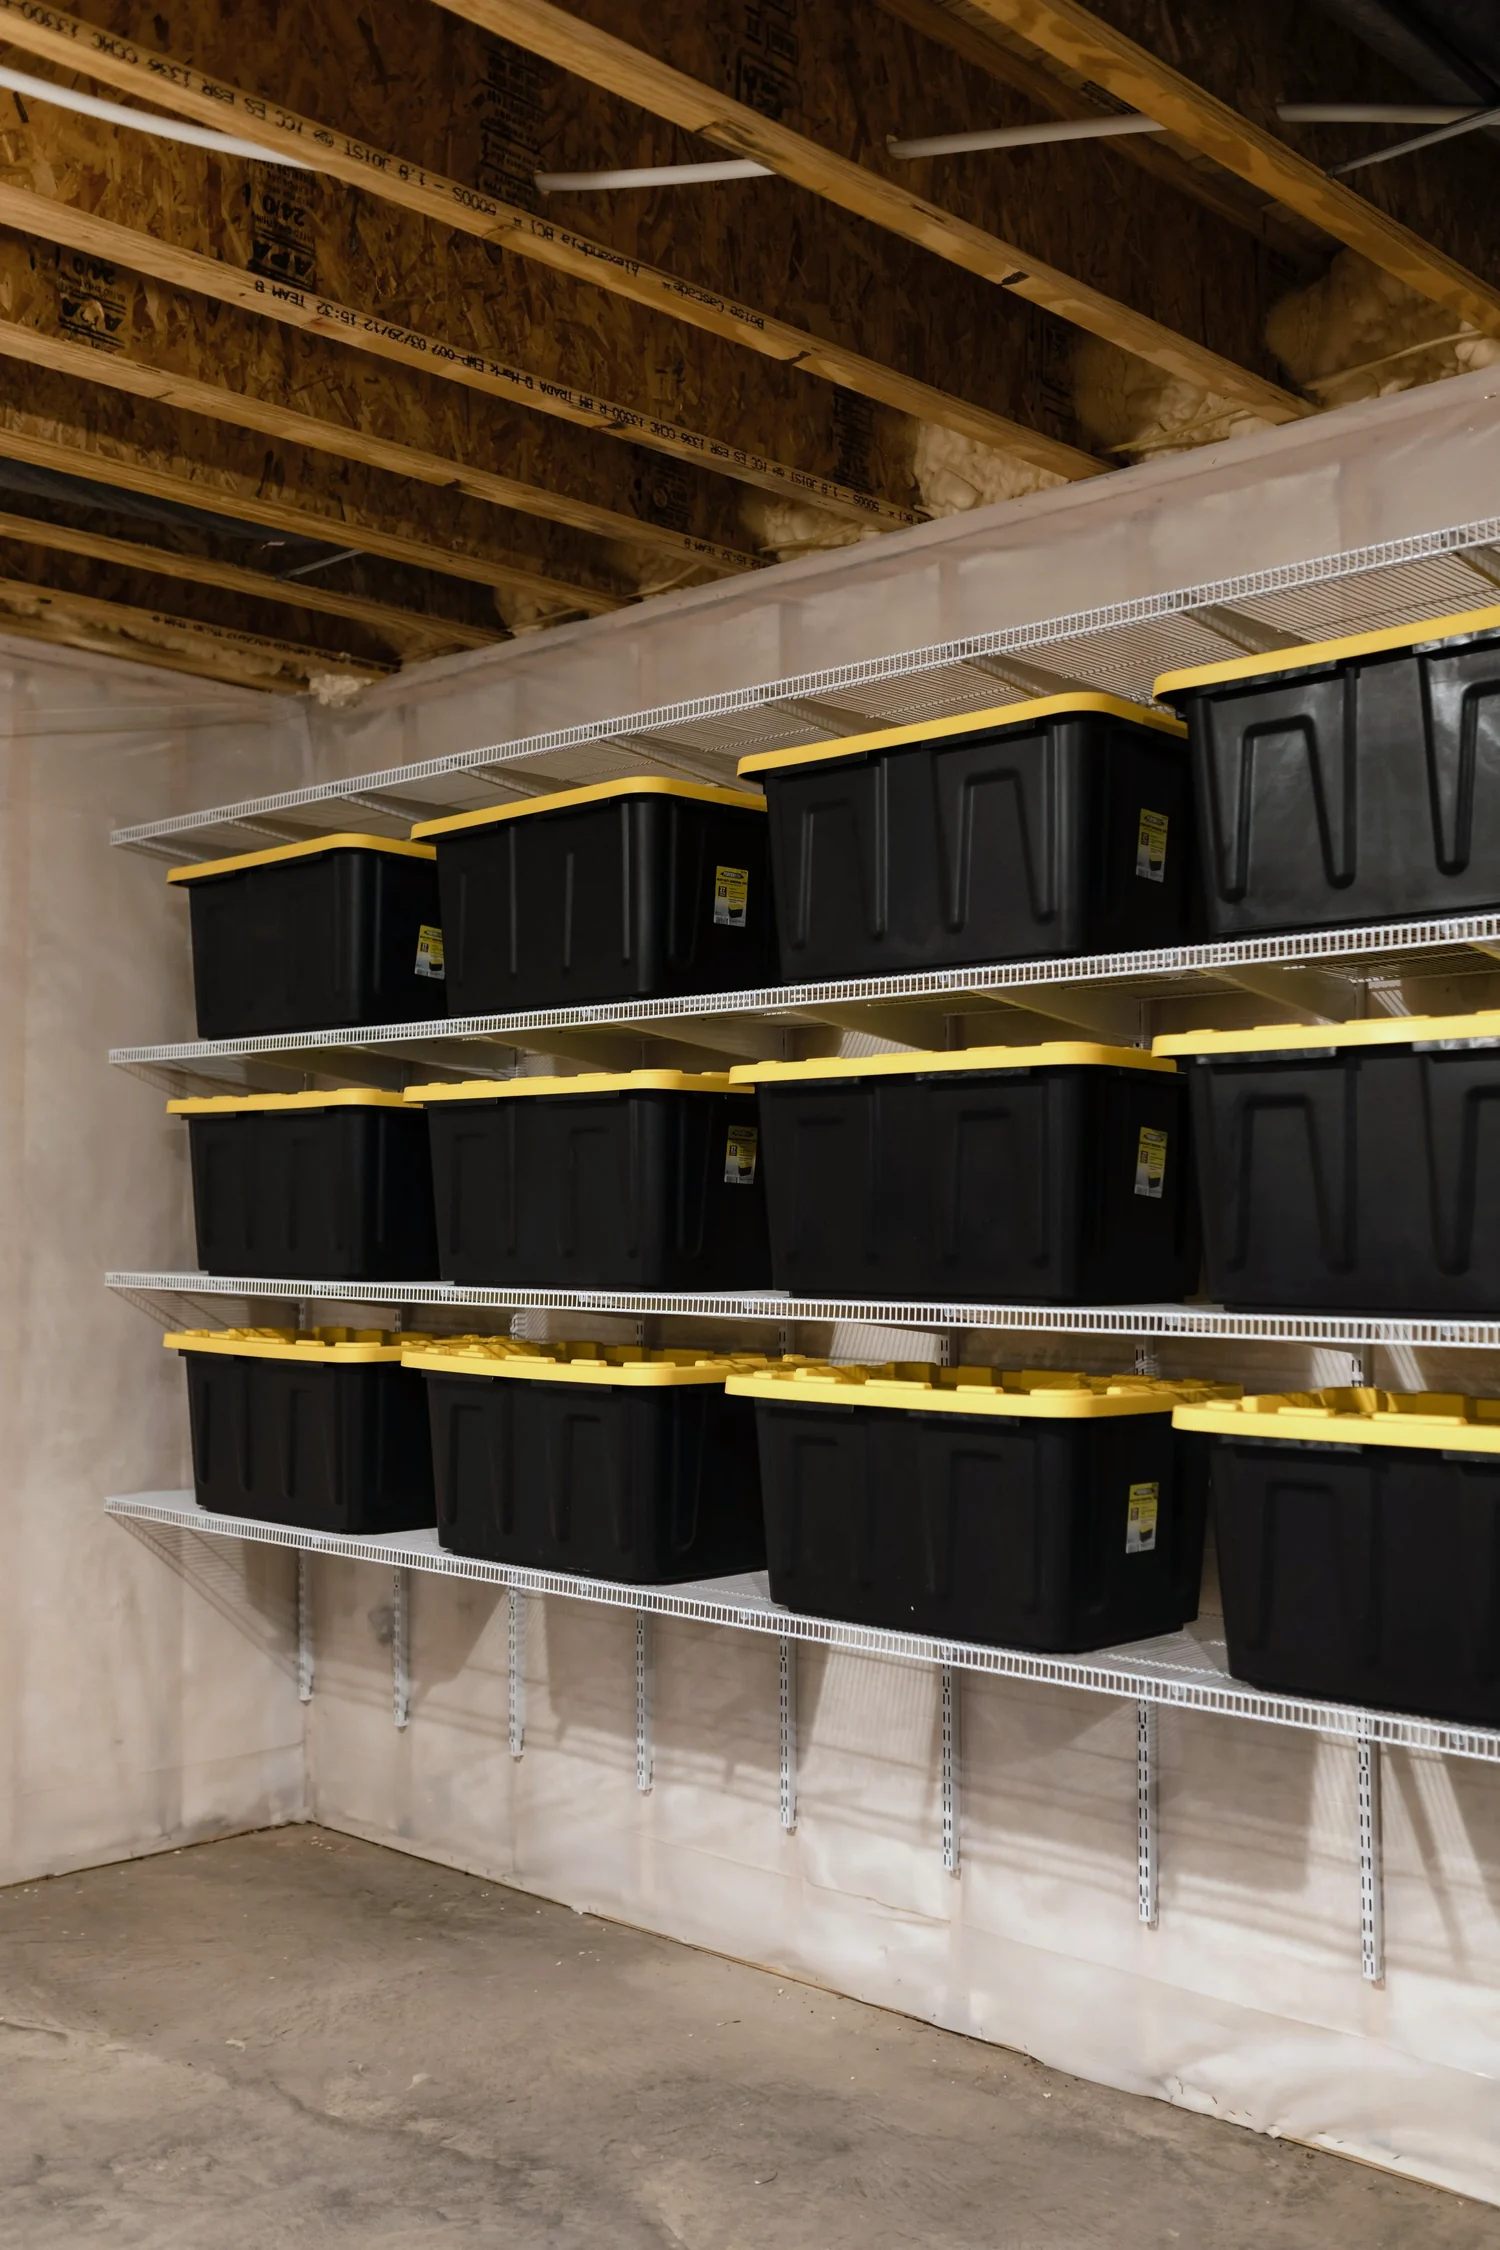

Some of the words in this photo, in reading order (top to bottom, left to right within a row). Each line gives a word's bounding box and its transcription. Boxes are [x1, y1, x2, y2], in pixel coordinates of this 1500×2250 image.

[91, 31, 139, 64] CCMC
[147, 57, 192, 88] 1336
[201, 77, 235, 105] ESR
[243, 97, 269, 121] ES
[275, 108, 304, 135] ICC
[343, 139, 392, 169] JOIST
[252, 240, 314, 277] APA
[560, 232, 643, 278] Alexandria
[253, 278, 265, 293] 8
[271, 285, 306, 309] TEAM
[315, 299, 357, 326] 15:32
[728, 305, 765, 330] Boise
[363, 317, 427, 351] 03/29/12
[539, 380, 572, 404] TRADA
[709, 441, 729, 458] ESR
[733, 447, 749, 466] ES
